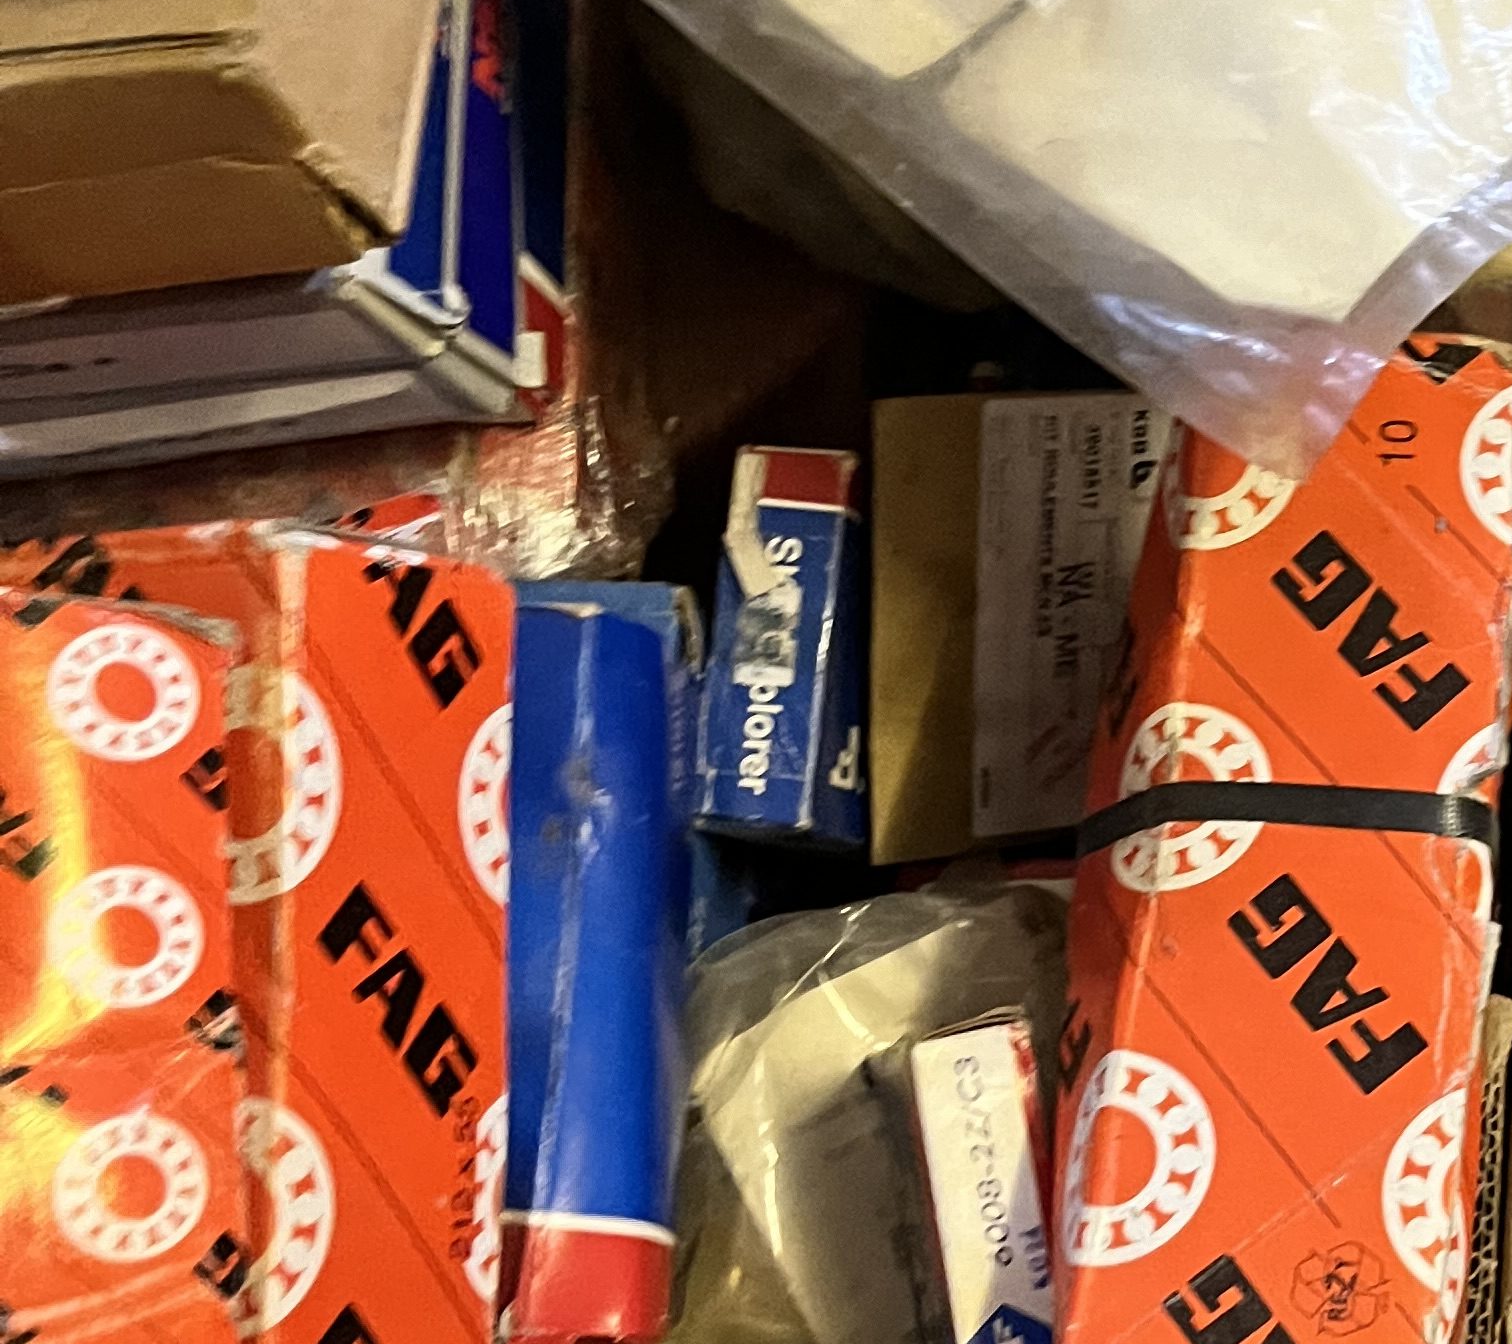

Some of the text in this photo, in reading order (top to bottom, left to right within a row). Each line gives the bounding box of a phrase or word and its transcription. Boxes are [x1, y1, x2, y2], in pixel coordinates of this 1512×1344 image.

[1271, 529, 1471, 732] FAG
[317, 881, 478, 1119] FAG
[1227, 872, 1429, 1096] FAG
